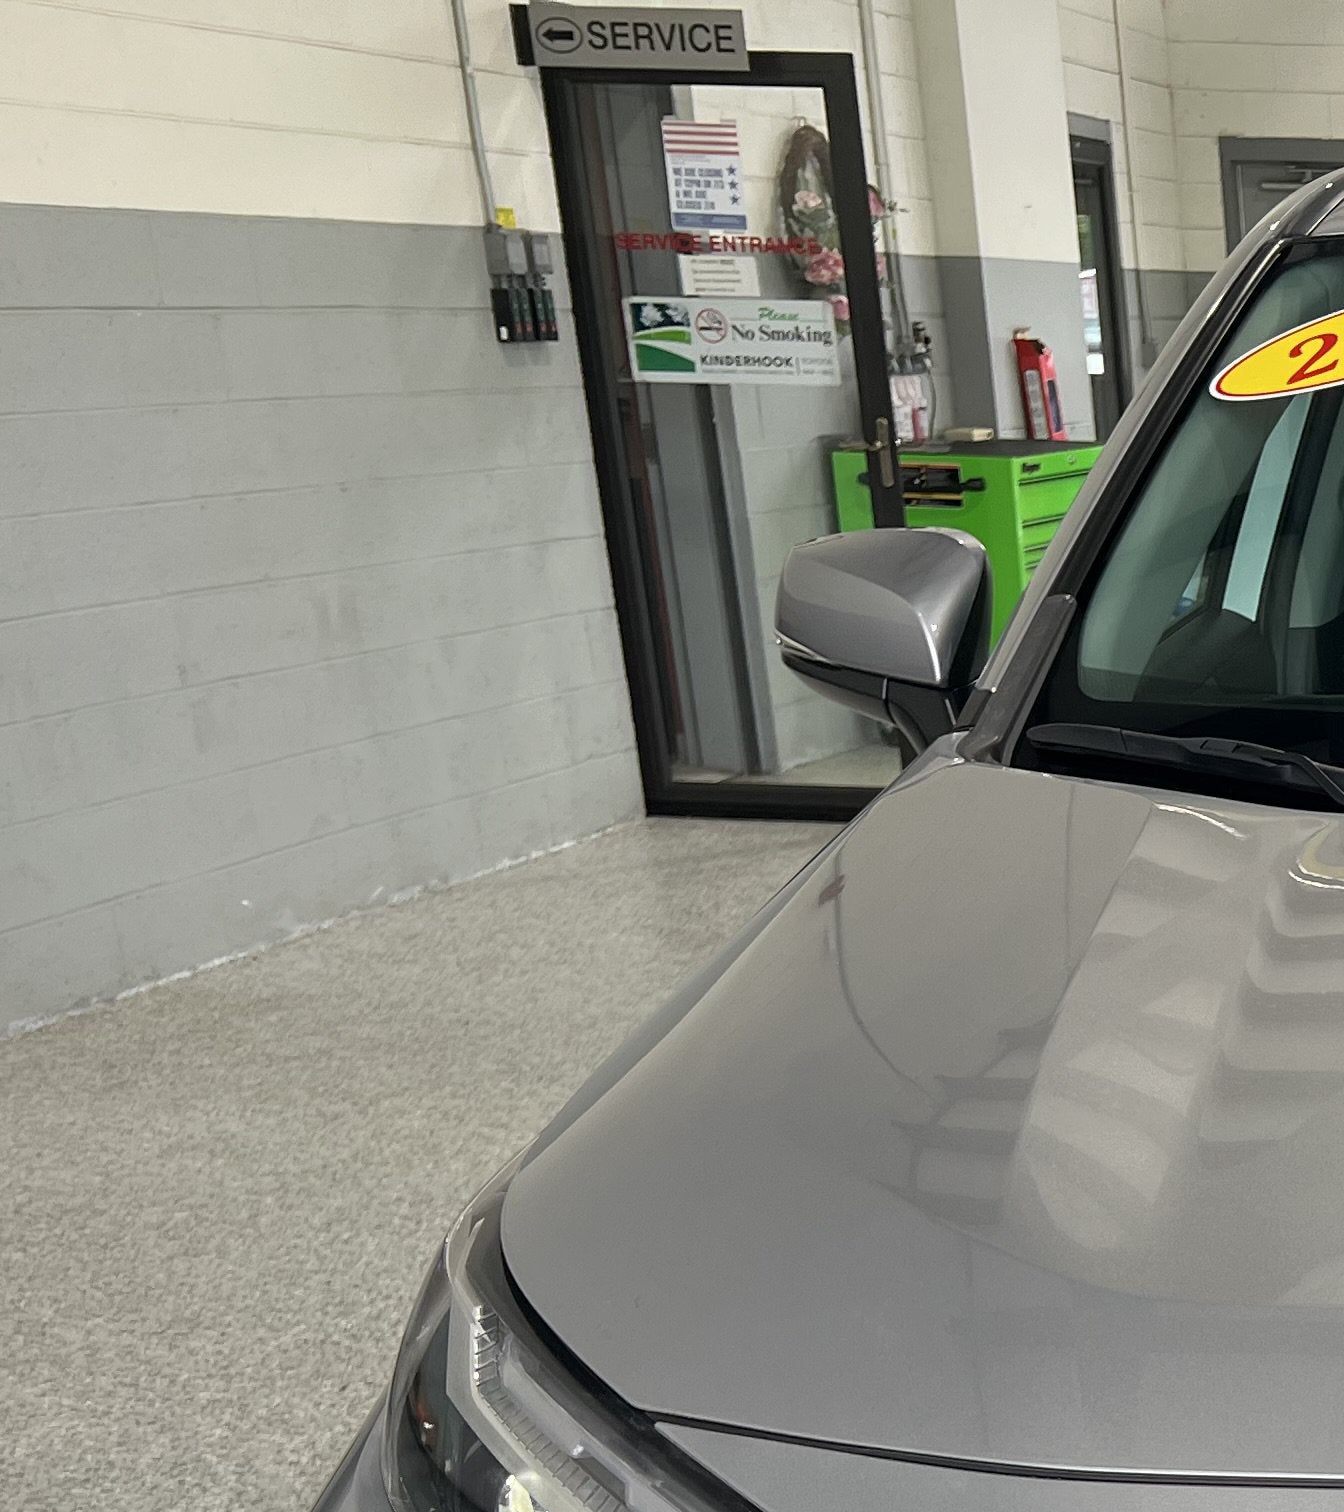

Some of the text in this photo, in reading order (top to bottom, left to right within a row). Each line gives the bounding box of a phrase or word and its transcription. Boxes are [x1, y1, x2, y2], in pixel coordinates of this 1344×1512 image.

[586, 20, 736, 53] SERVICE
[616, 232, 819, 255] SERVICE ENTRANCE
[731, 324, 833, 347] No Smoking
[700, 354, 794, 367] KINDERHOOK
